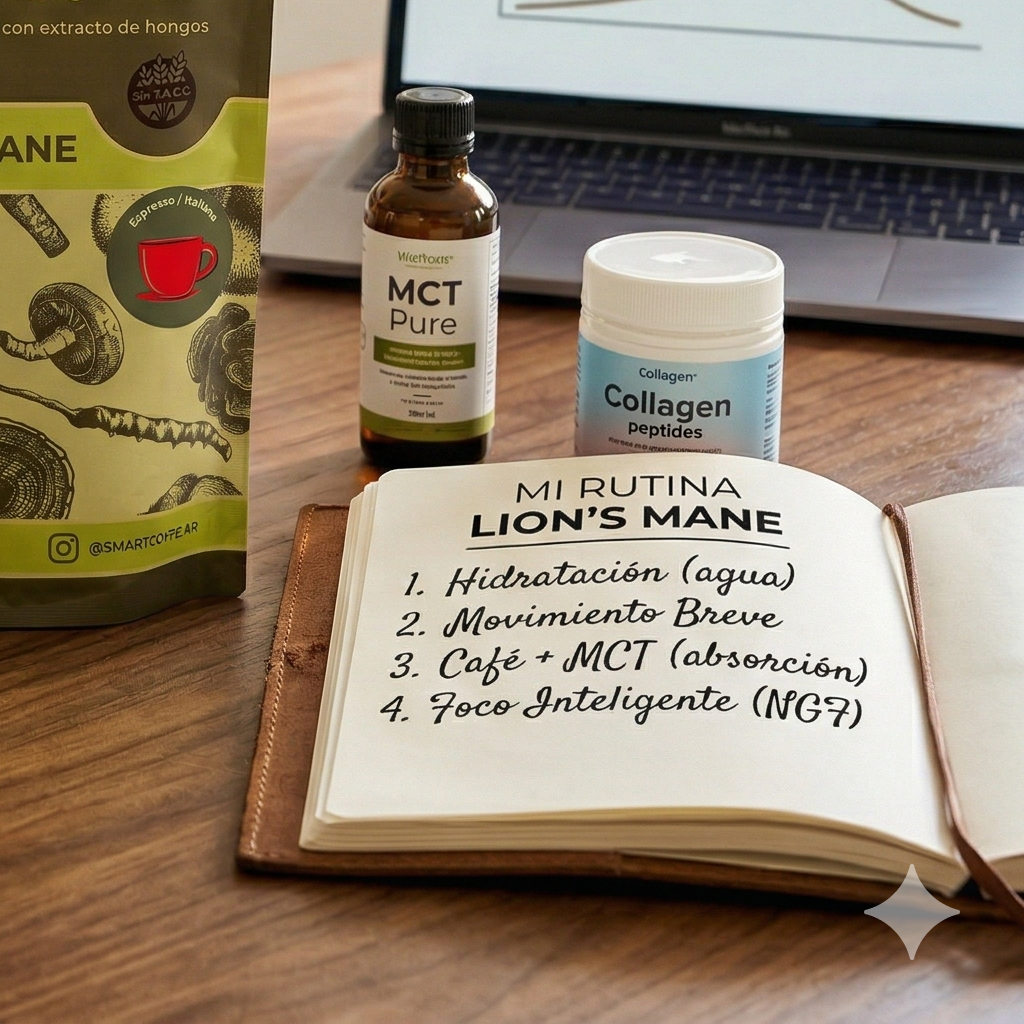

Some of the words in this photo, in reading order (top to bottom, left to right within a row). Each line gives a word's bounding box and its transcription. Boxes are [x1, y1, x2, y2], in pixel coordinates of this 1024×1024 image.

[2, 23, 34, 35] con
[39, 21, 113, 35] extracto
[117, 20, 140, 34] de
[145, 19, 209, 37] hongos
[132, 90, 151, 102] Sin
[388, 275, 463, 306] MCT
[390, 308, 457, 335] Pure
[604, 383, 731, 423] Collagen
[628, 421, 703, 439] peptides
[516, 479, 562, 503] MI
[580, 475, 742, 499] RUTINA
[471, 506, 627, 538] LION'S
[643, 505, 783, 536] MANE
[404, 571, 424, 596] 1.
[445, 561, 669, 597] Hidratación
[682, 554, 795, 596] (agua)
[396, 611, 426, 637] 2.
[443, 599, 665, 638] Movimiento
[673, 597, 784, 628] Breve
[389, 652, 419, 679] 3.
[439, 646, 526, 686] Café
[535, 650, 554, 663] +
[562, 639, 658, 673] MCT
[670, 638, 868, 687] (absorción)
[380, 695, 409, 722] 4.
[429, 691, 520, 724] Foco
[523, 685, 739, 725] Inteligente
